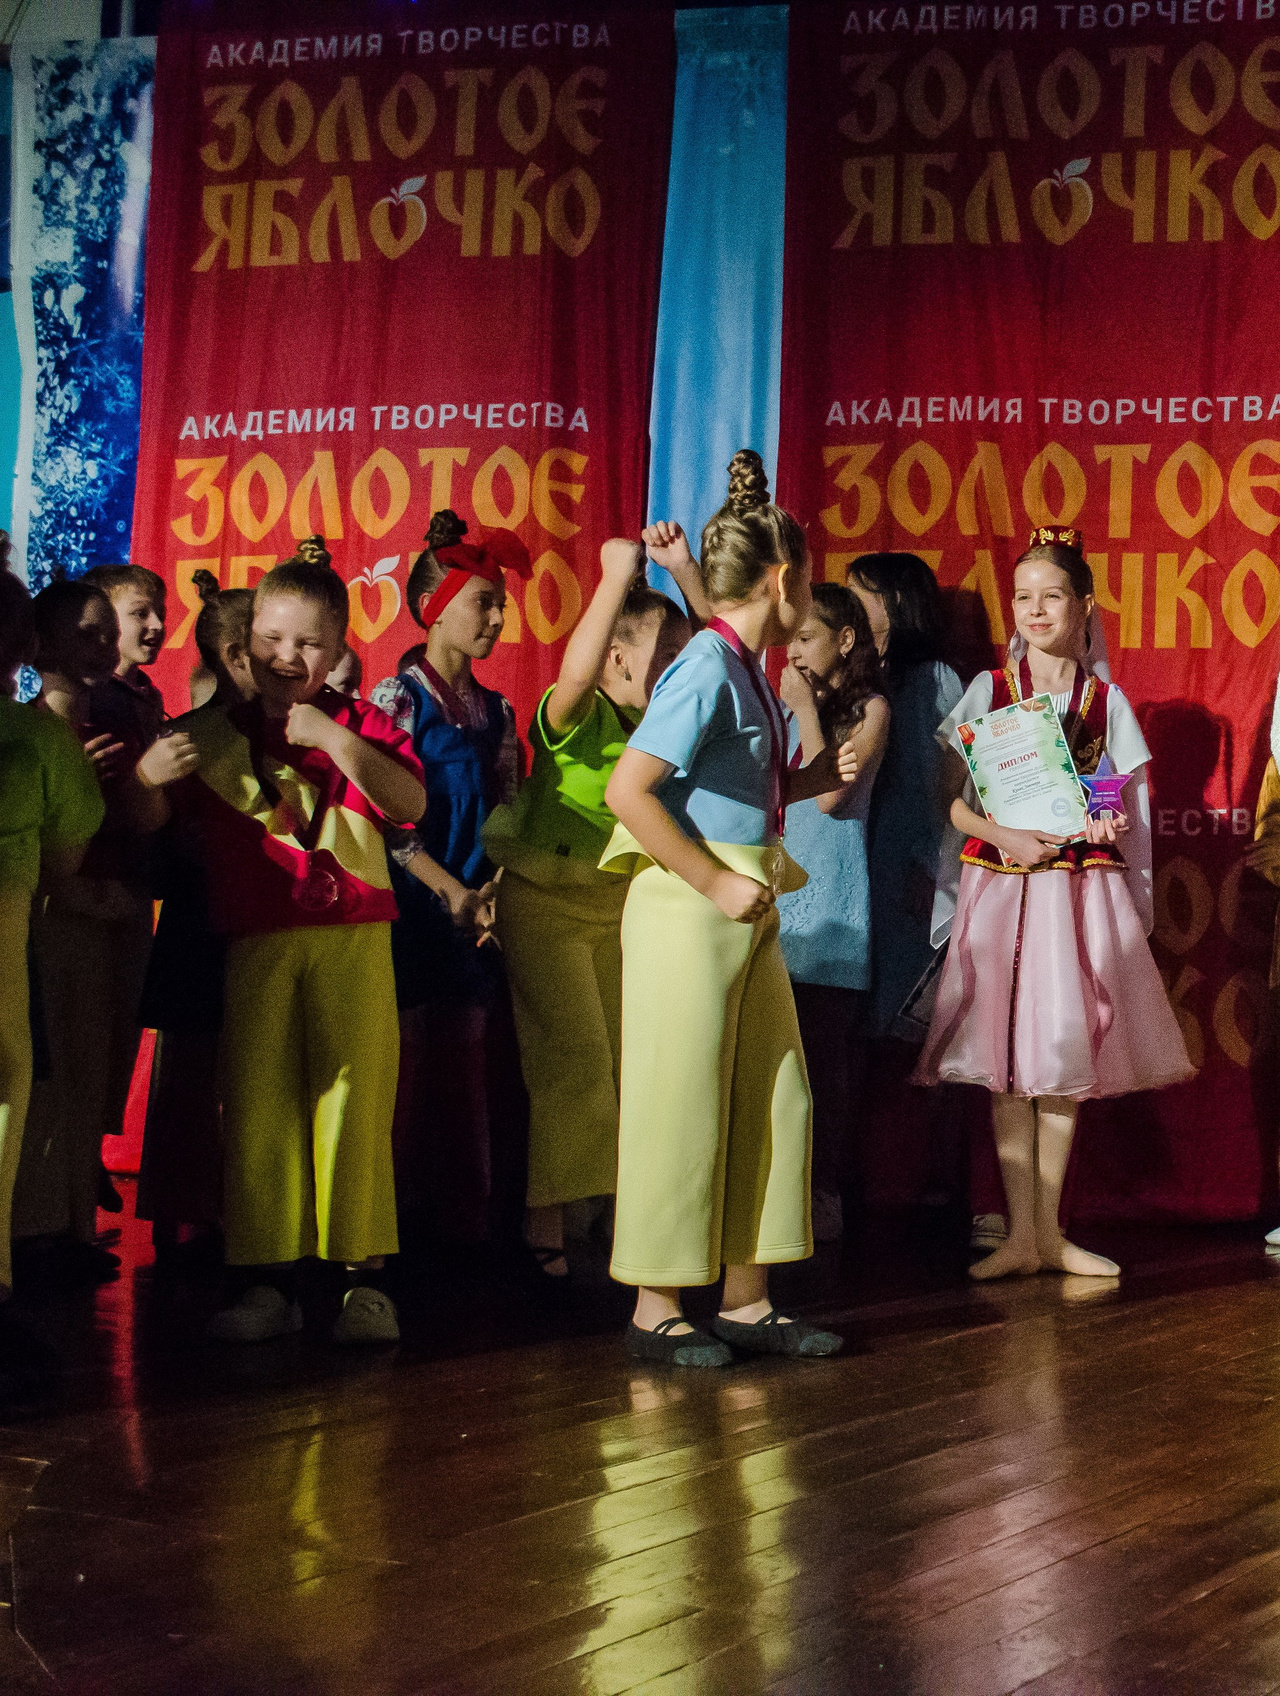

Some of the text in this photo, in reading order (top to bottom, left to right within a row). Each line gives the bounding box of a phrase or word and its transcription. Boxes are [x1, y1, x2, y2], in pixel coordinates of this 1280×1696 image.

[842, 4, 1039, 35] АКАДЕМИЯ
[205, 22, 612, 69] АКАДЕМИЯ ТВОРЧЕСТВА
[198, 63, 609, 173] ЗОЛОТОЕ
[191, 162, 602, 273] ЯБЛОЧКО
[179, 401, 591, 441] АКАДЕМИЯ ТВОРЧЕСТВА
[825, 395, 1024, 428] АКАДЕМИЯ
[170, 444, 591, 547] ЗОЛОТОЕ
[997, 751, 1039, 773] ДИПЛОМ
